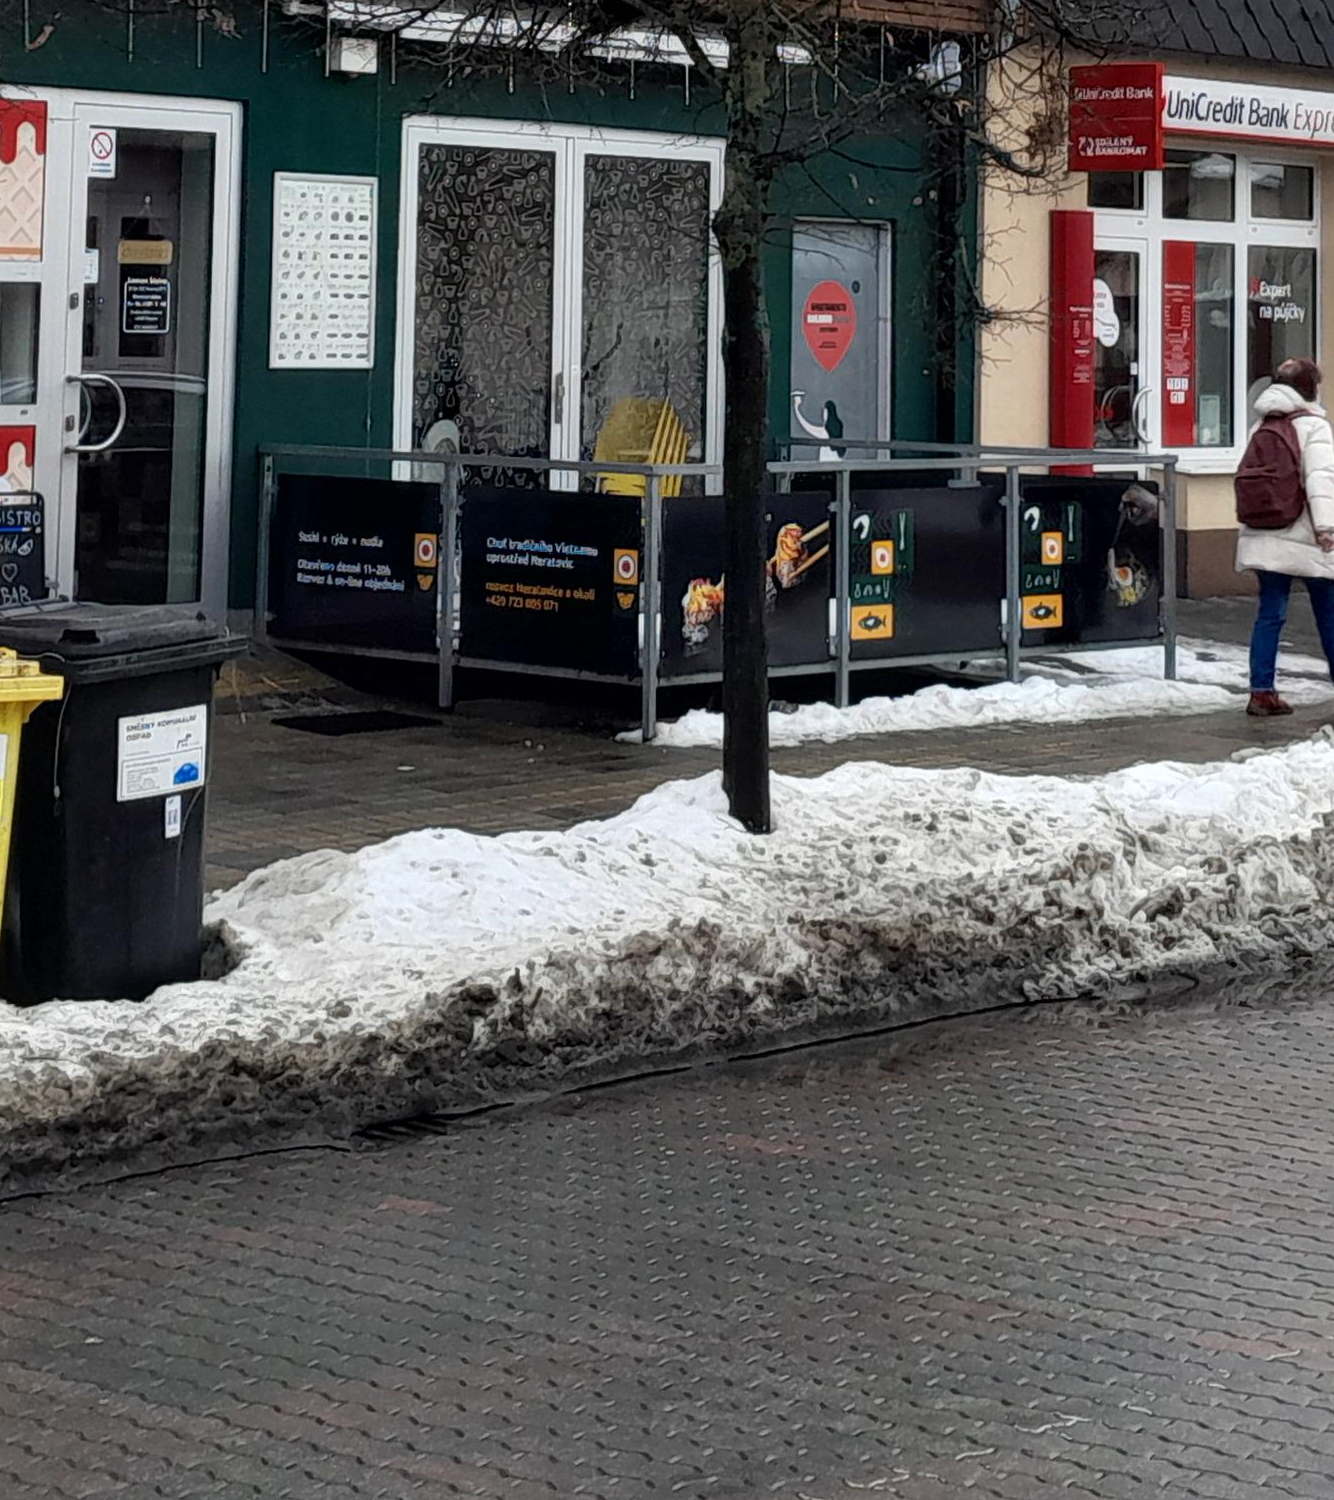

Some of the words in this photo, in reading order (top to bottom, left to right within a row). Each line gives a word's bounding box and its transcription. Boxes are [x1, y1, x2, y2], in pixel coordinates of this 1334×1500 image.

[1126, 85, 1154, 99] Bank
[1166, 90, 1246, 125] UniCredit
[1248, 97, 1290, 130] Bank
[1259, 280, 1292, 301] Expert
[1258, 306, 1273, 319] na
[0, 585, 32, 606] BAR
